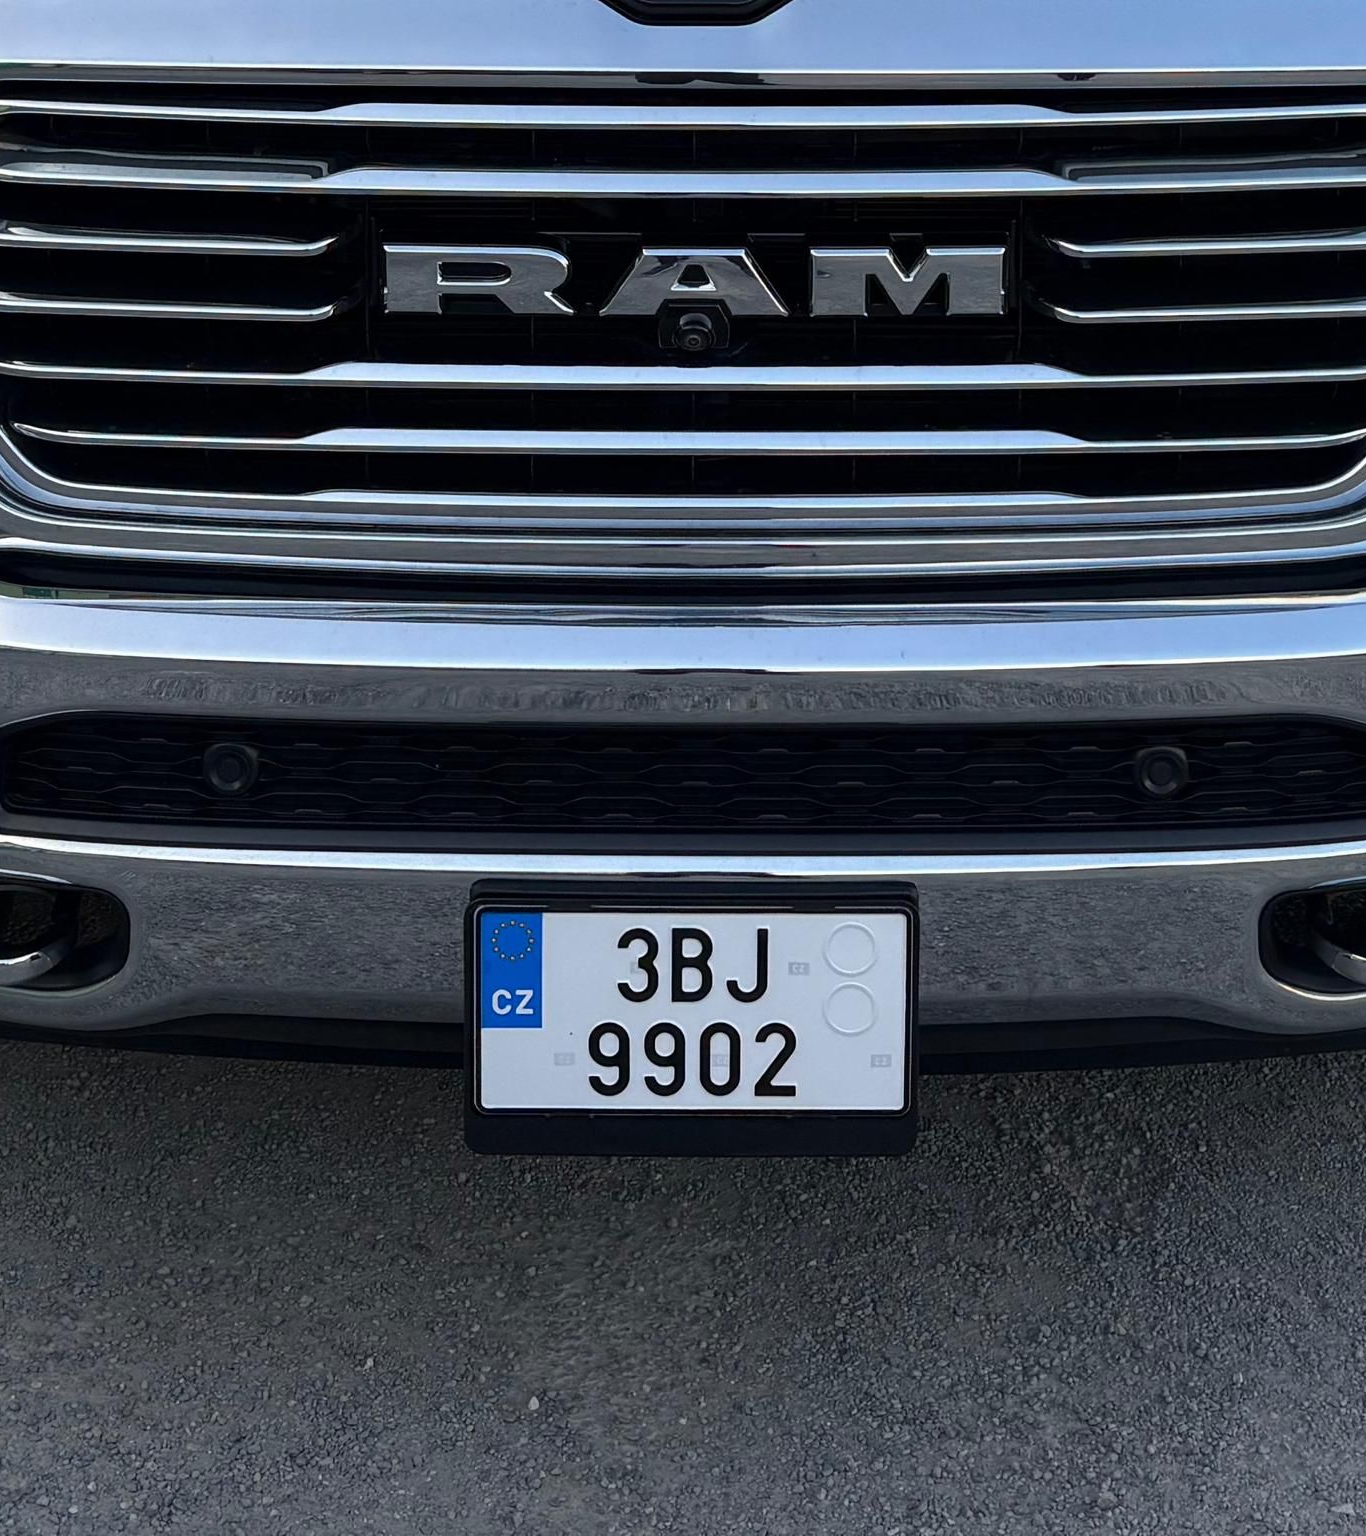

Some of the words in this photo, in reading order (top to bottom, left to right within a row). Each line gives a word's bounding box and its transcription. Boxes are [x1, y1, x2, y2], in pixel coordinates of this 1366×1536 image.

[383, 244, 1008, 316] RAM
[492, 989, 534, 1015] CZ
[617, 927, 769, 1003] 3BJ
[588, 1021, 797, 1097] 9902
